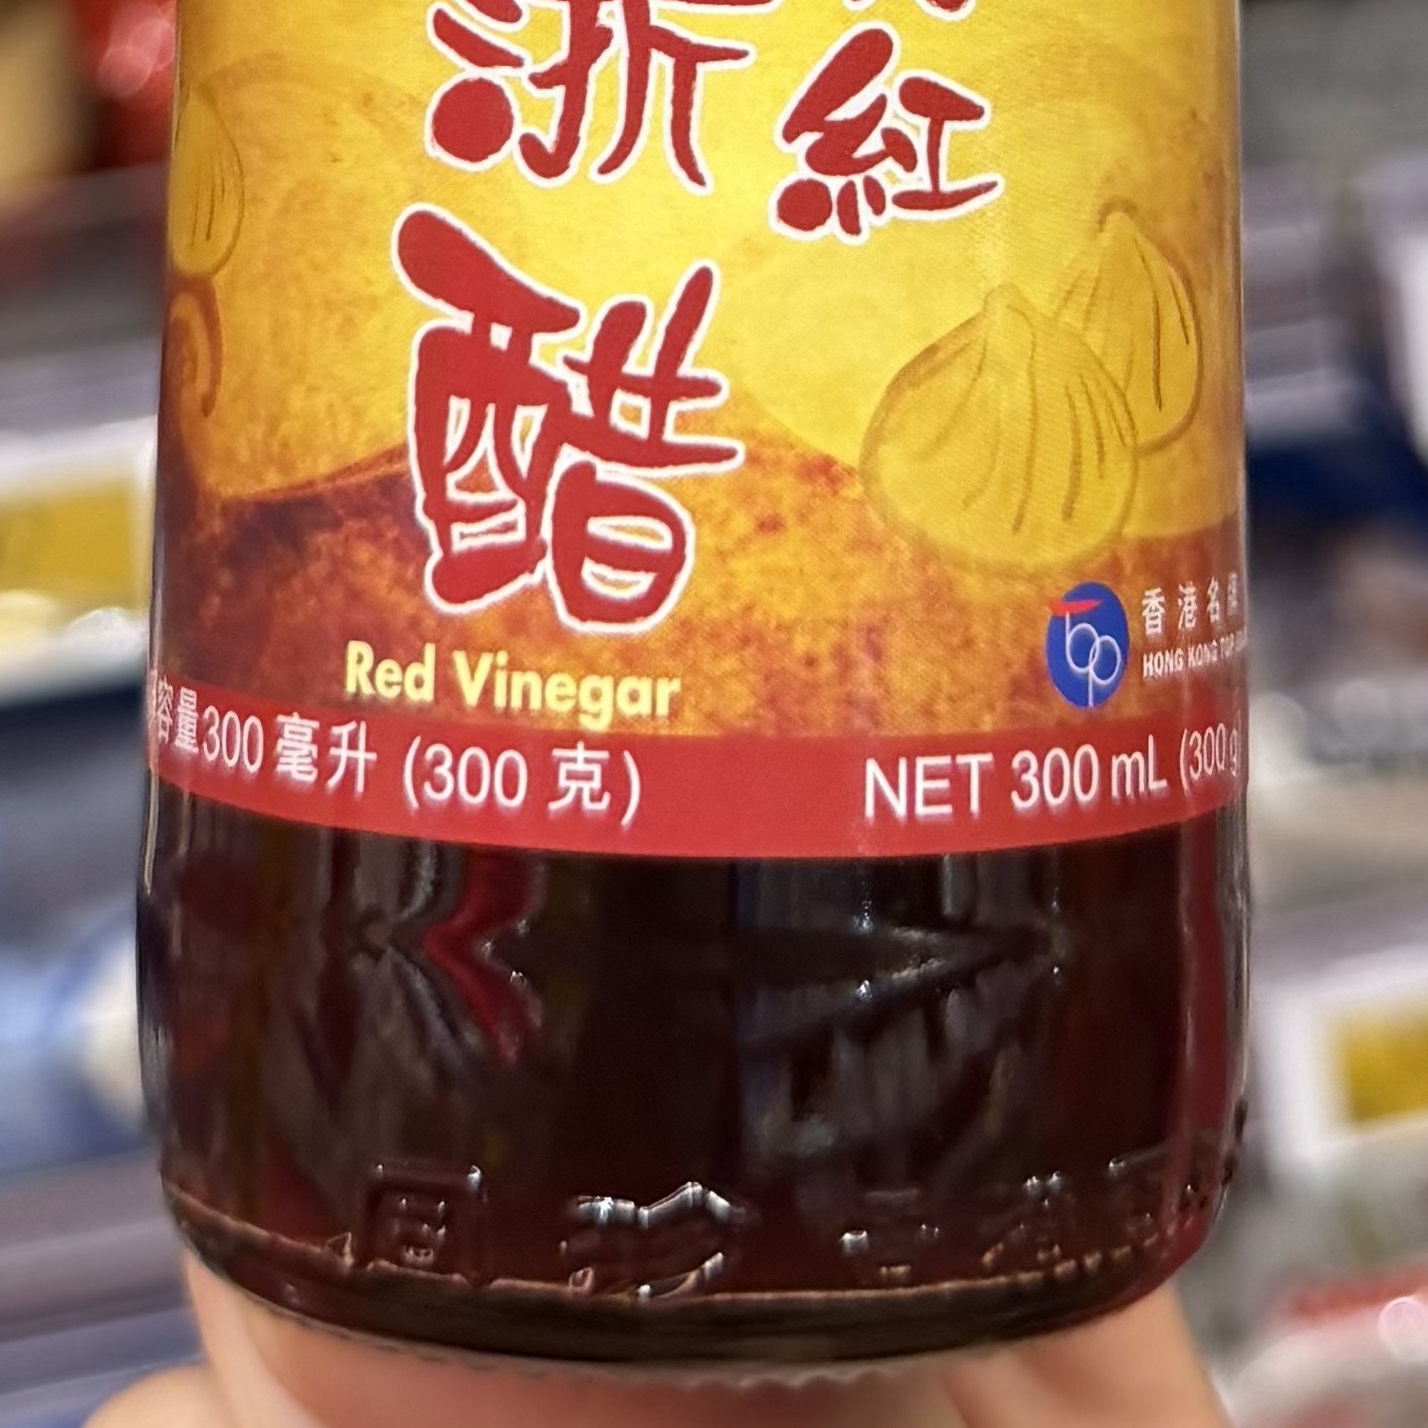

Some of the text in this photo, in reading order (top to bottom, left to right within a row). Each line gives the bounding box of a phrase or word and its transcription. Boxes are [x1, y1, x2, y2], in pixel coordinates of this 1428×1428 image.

[345, 641, 682, 734] Red Vinegar
[1142, 647, 1184, 678] HONG
[1187, 640, 1218, 668] KONG
[148, 677, 264, 774] 容量300
[274, 711, 378, 796] 毫升
[403, 736, 529, 810] (300
[864, 750, 995, 820] NET
[1009, 743, 1100, 812] 300
[1110, 733, 1169, 801] mL
